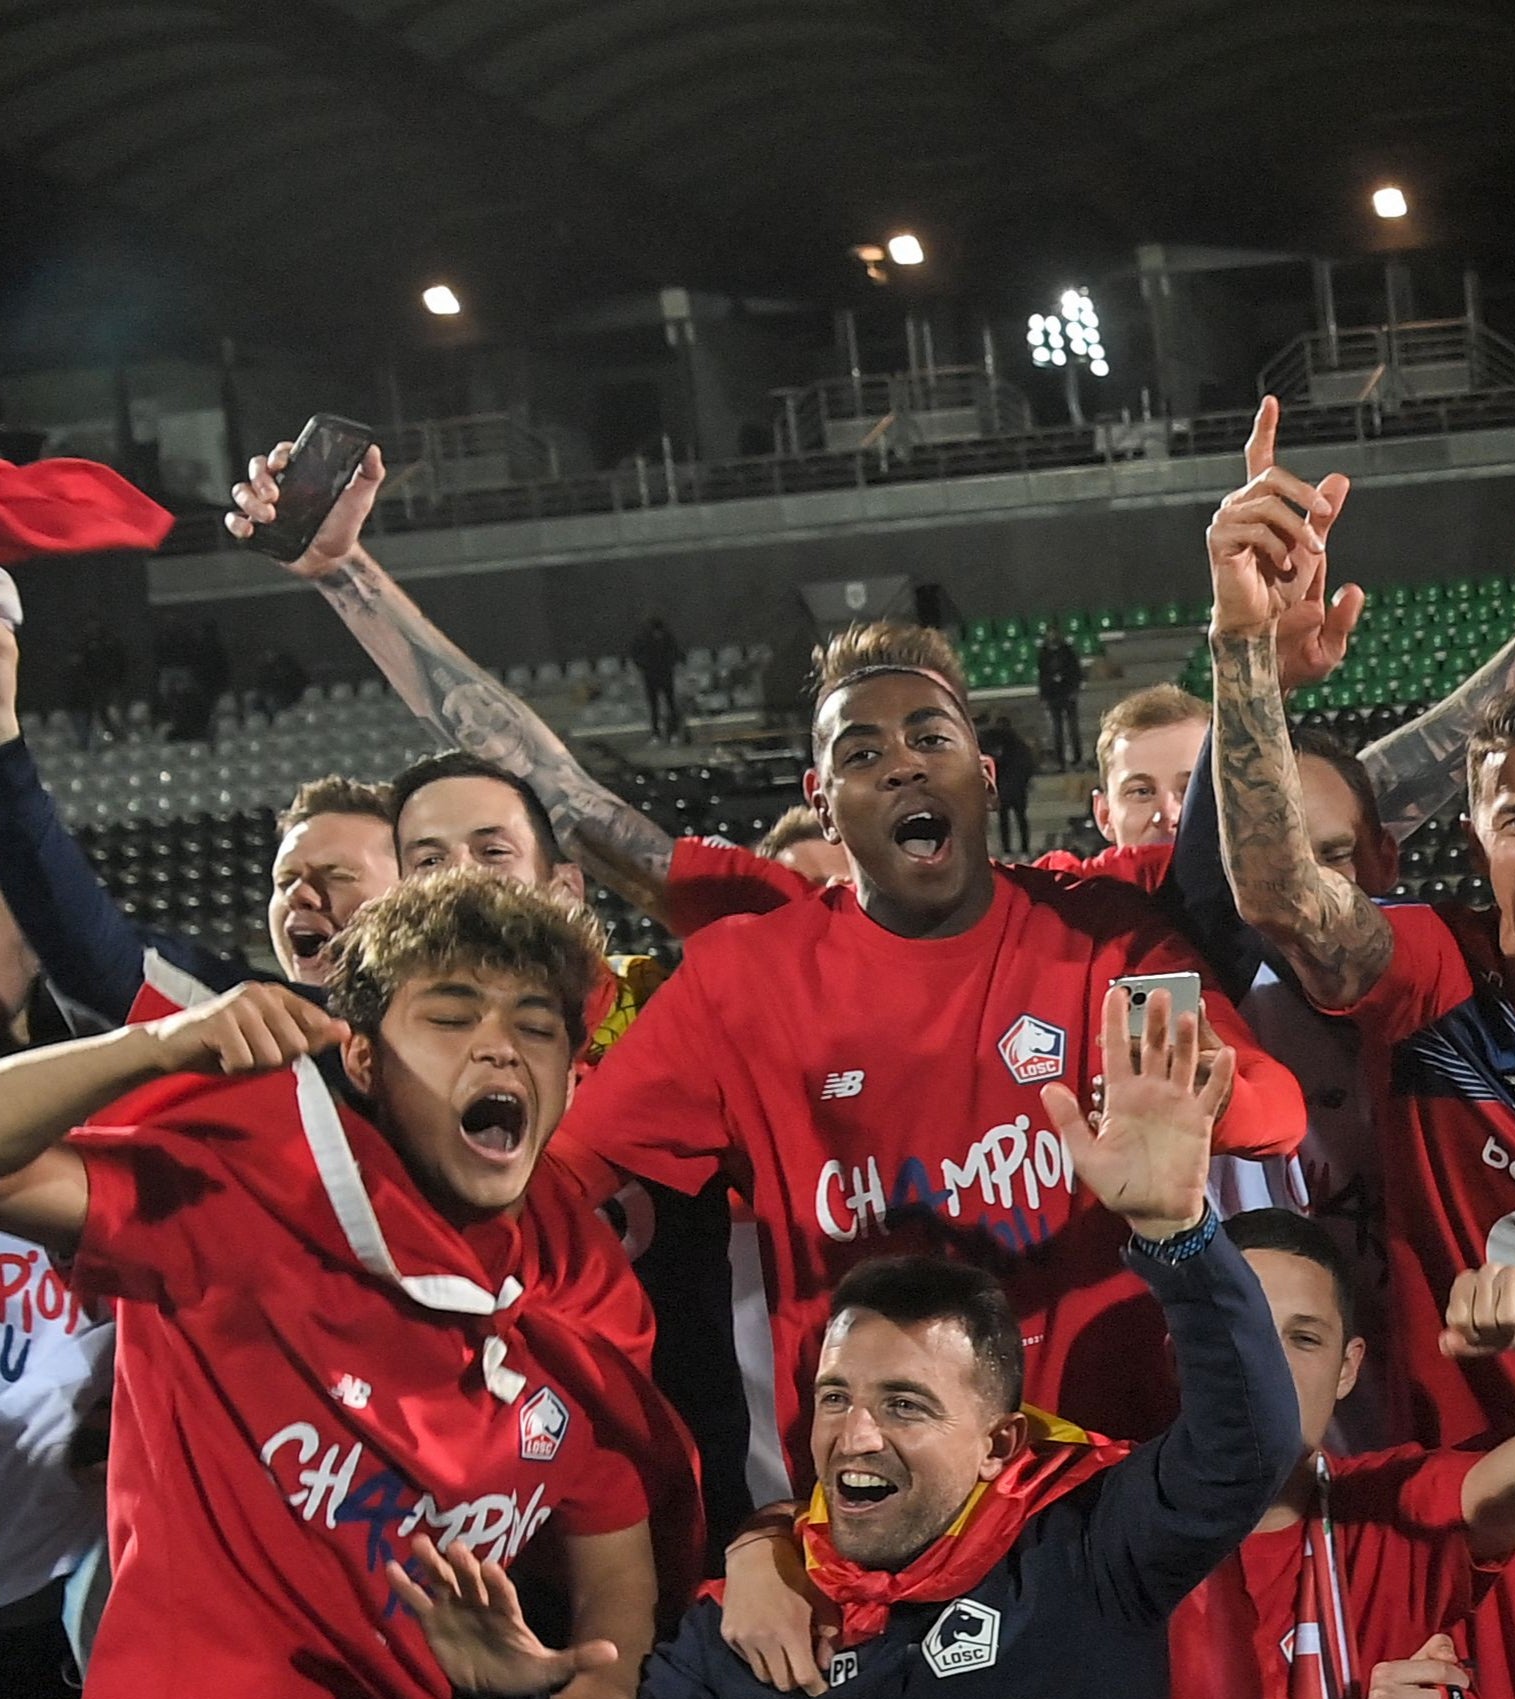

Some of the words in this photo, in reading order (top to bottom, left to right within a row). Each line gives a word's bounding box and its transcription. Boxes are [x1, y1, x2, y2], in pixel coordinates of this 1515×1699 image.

[1020, 1060, 1056, 1078] LOSC
[942, 1648, 985, 1666] LOSC
[833, 1657, 856, 1683] PP
